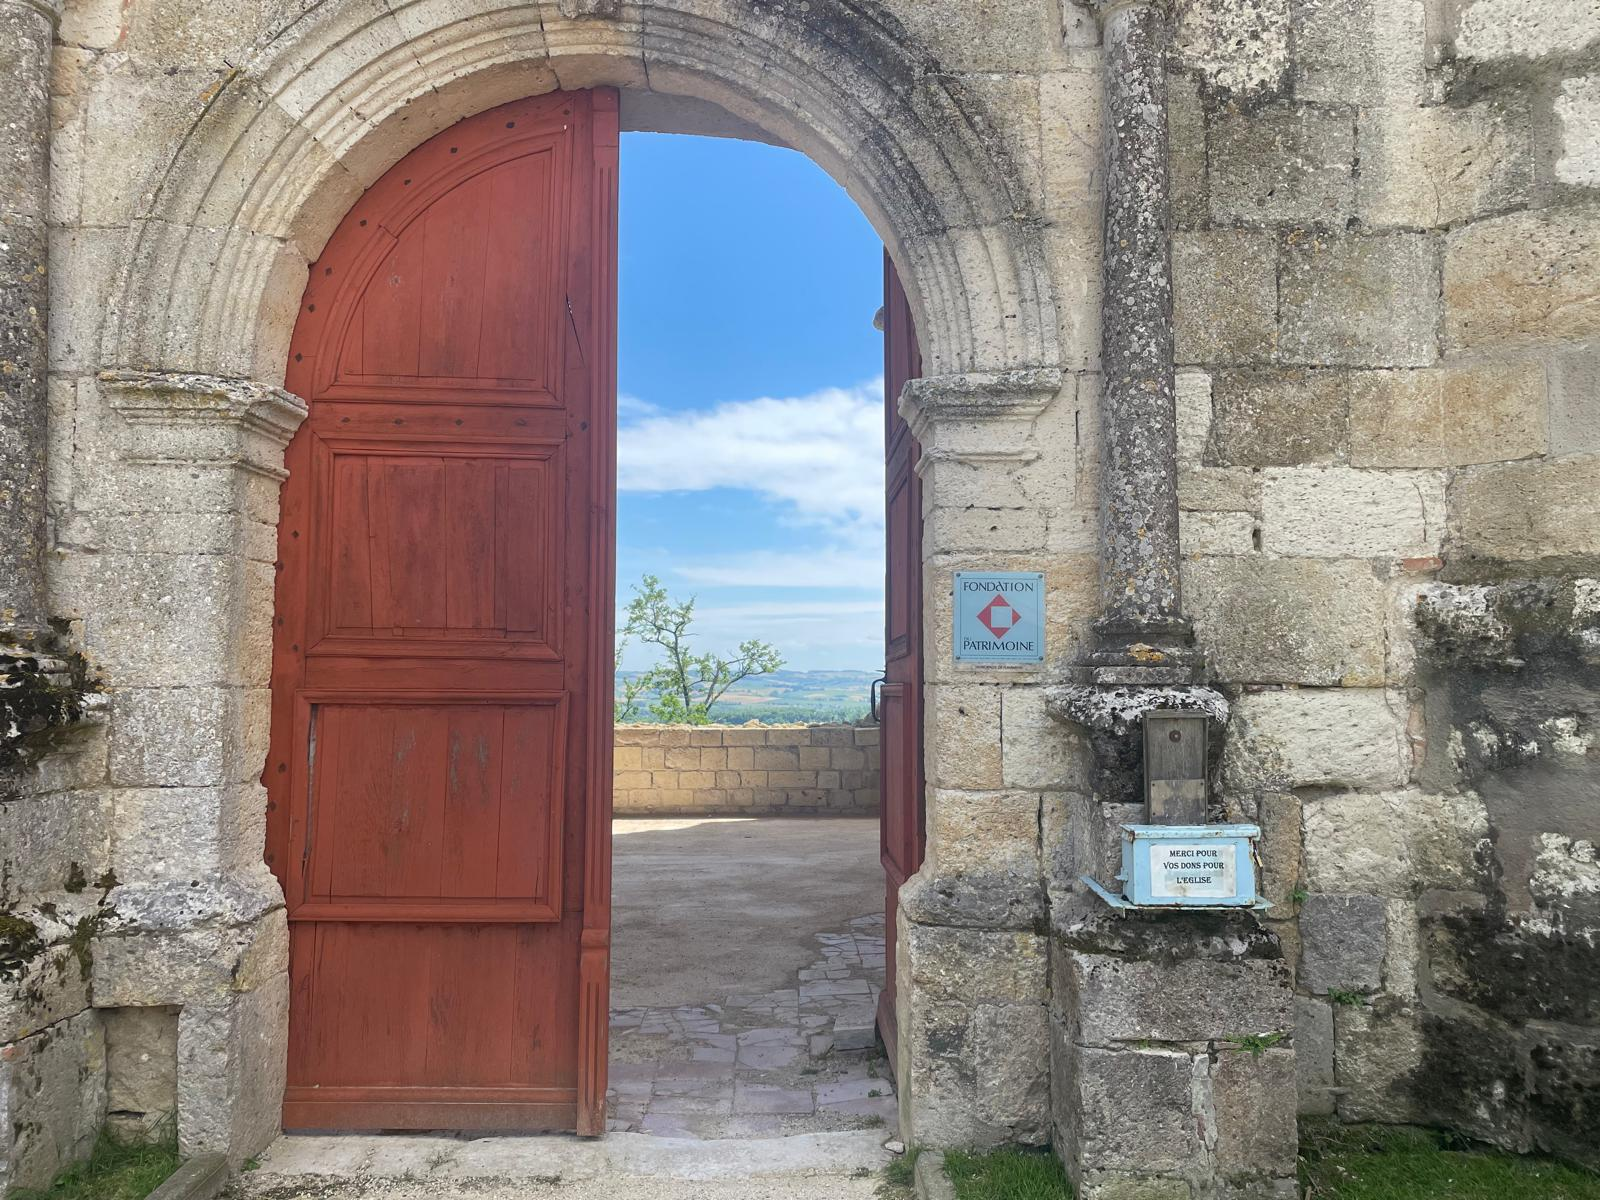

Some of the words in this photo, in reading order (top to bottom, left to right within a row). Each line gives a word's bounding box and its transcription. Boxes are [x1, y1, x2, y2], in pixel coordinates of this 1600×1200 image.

[963, 581, 1034, 592] FONDATION
[963, 641, 1034, 651] PATRIMOINE
[1176, 876, 1212, 884] L'EGLISE
